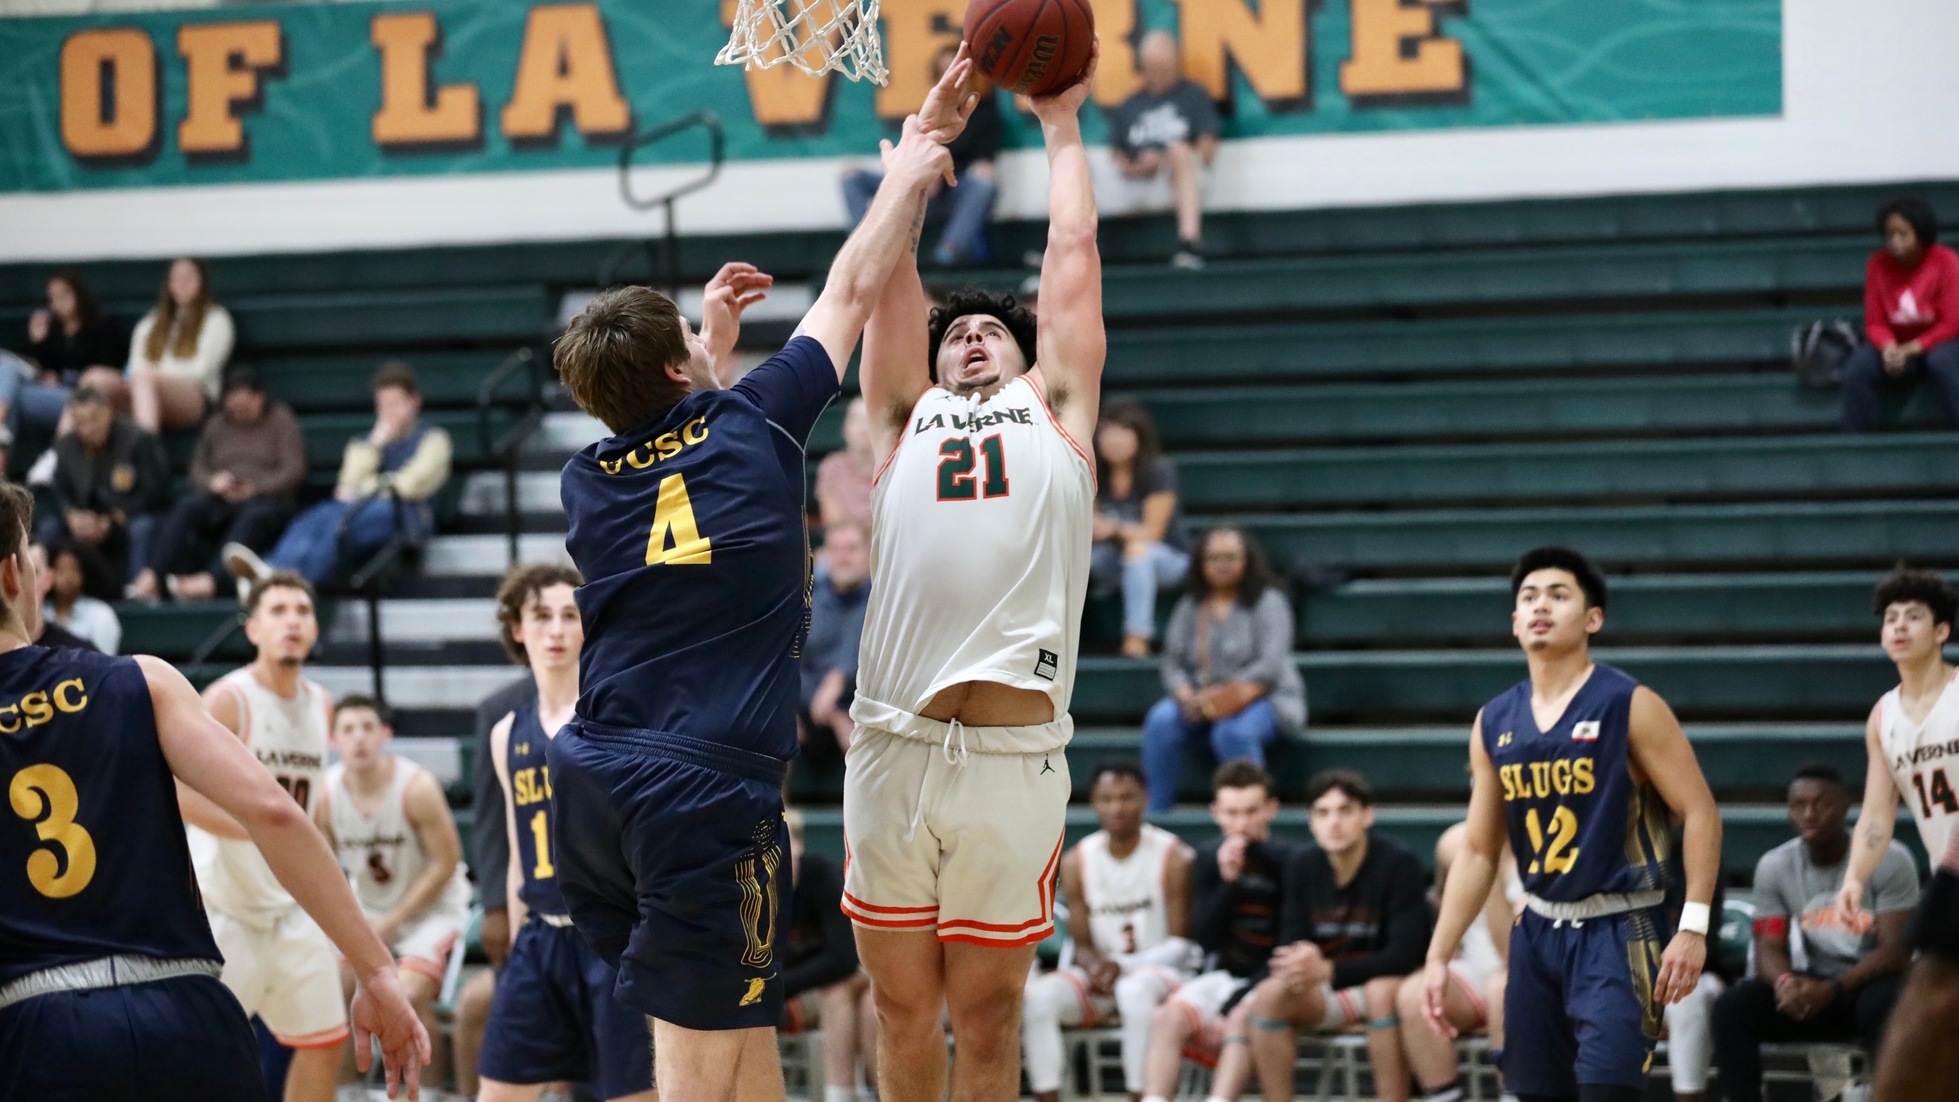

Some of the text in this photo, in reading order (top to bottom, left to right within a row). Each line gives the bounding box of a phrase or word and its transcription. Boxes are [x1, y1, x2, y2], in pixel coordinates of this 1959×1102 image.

[60, 20, 285, 160] OF
[371, 4, 635, 145] LA
[914, 413, 945, 436] LA
[936, 433, 1010, 502] 21
[645, 473, 712, 566] 4
[1044, 652, 1054, 664] XL
[0, 677, 88, 733] CSC
[275, 774, 310, 812] 0
[1499, 757, 1595, 801] SLUGS
[1912, 767, 1959, 818] 14
[9, 763, 96, 898] 3
[1525, 805, 1578, 875] 12
